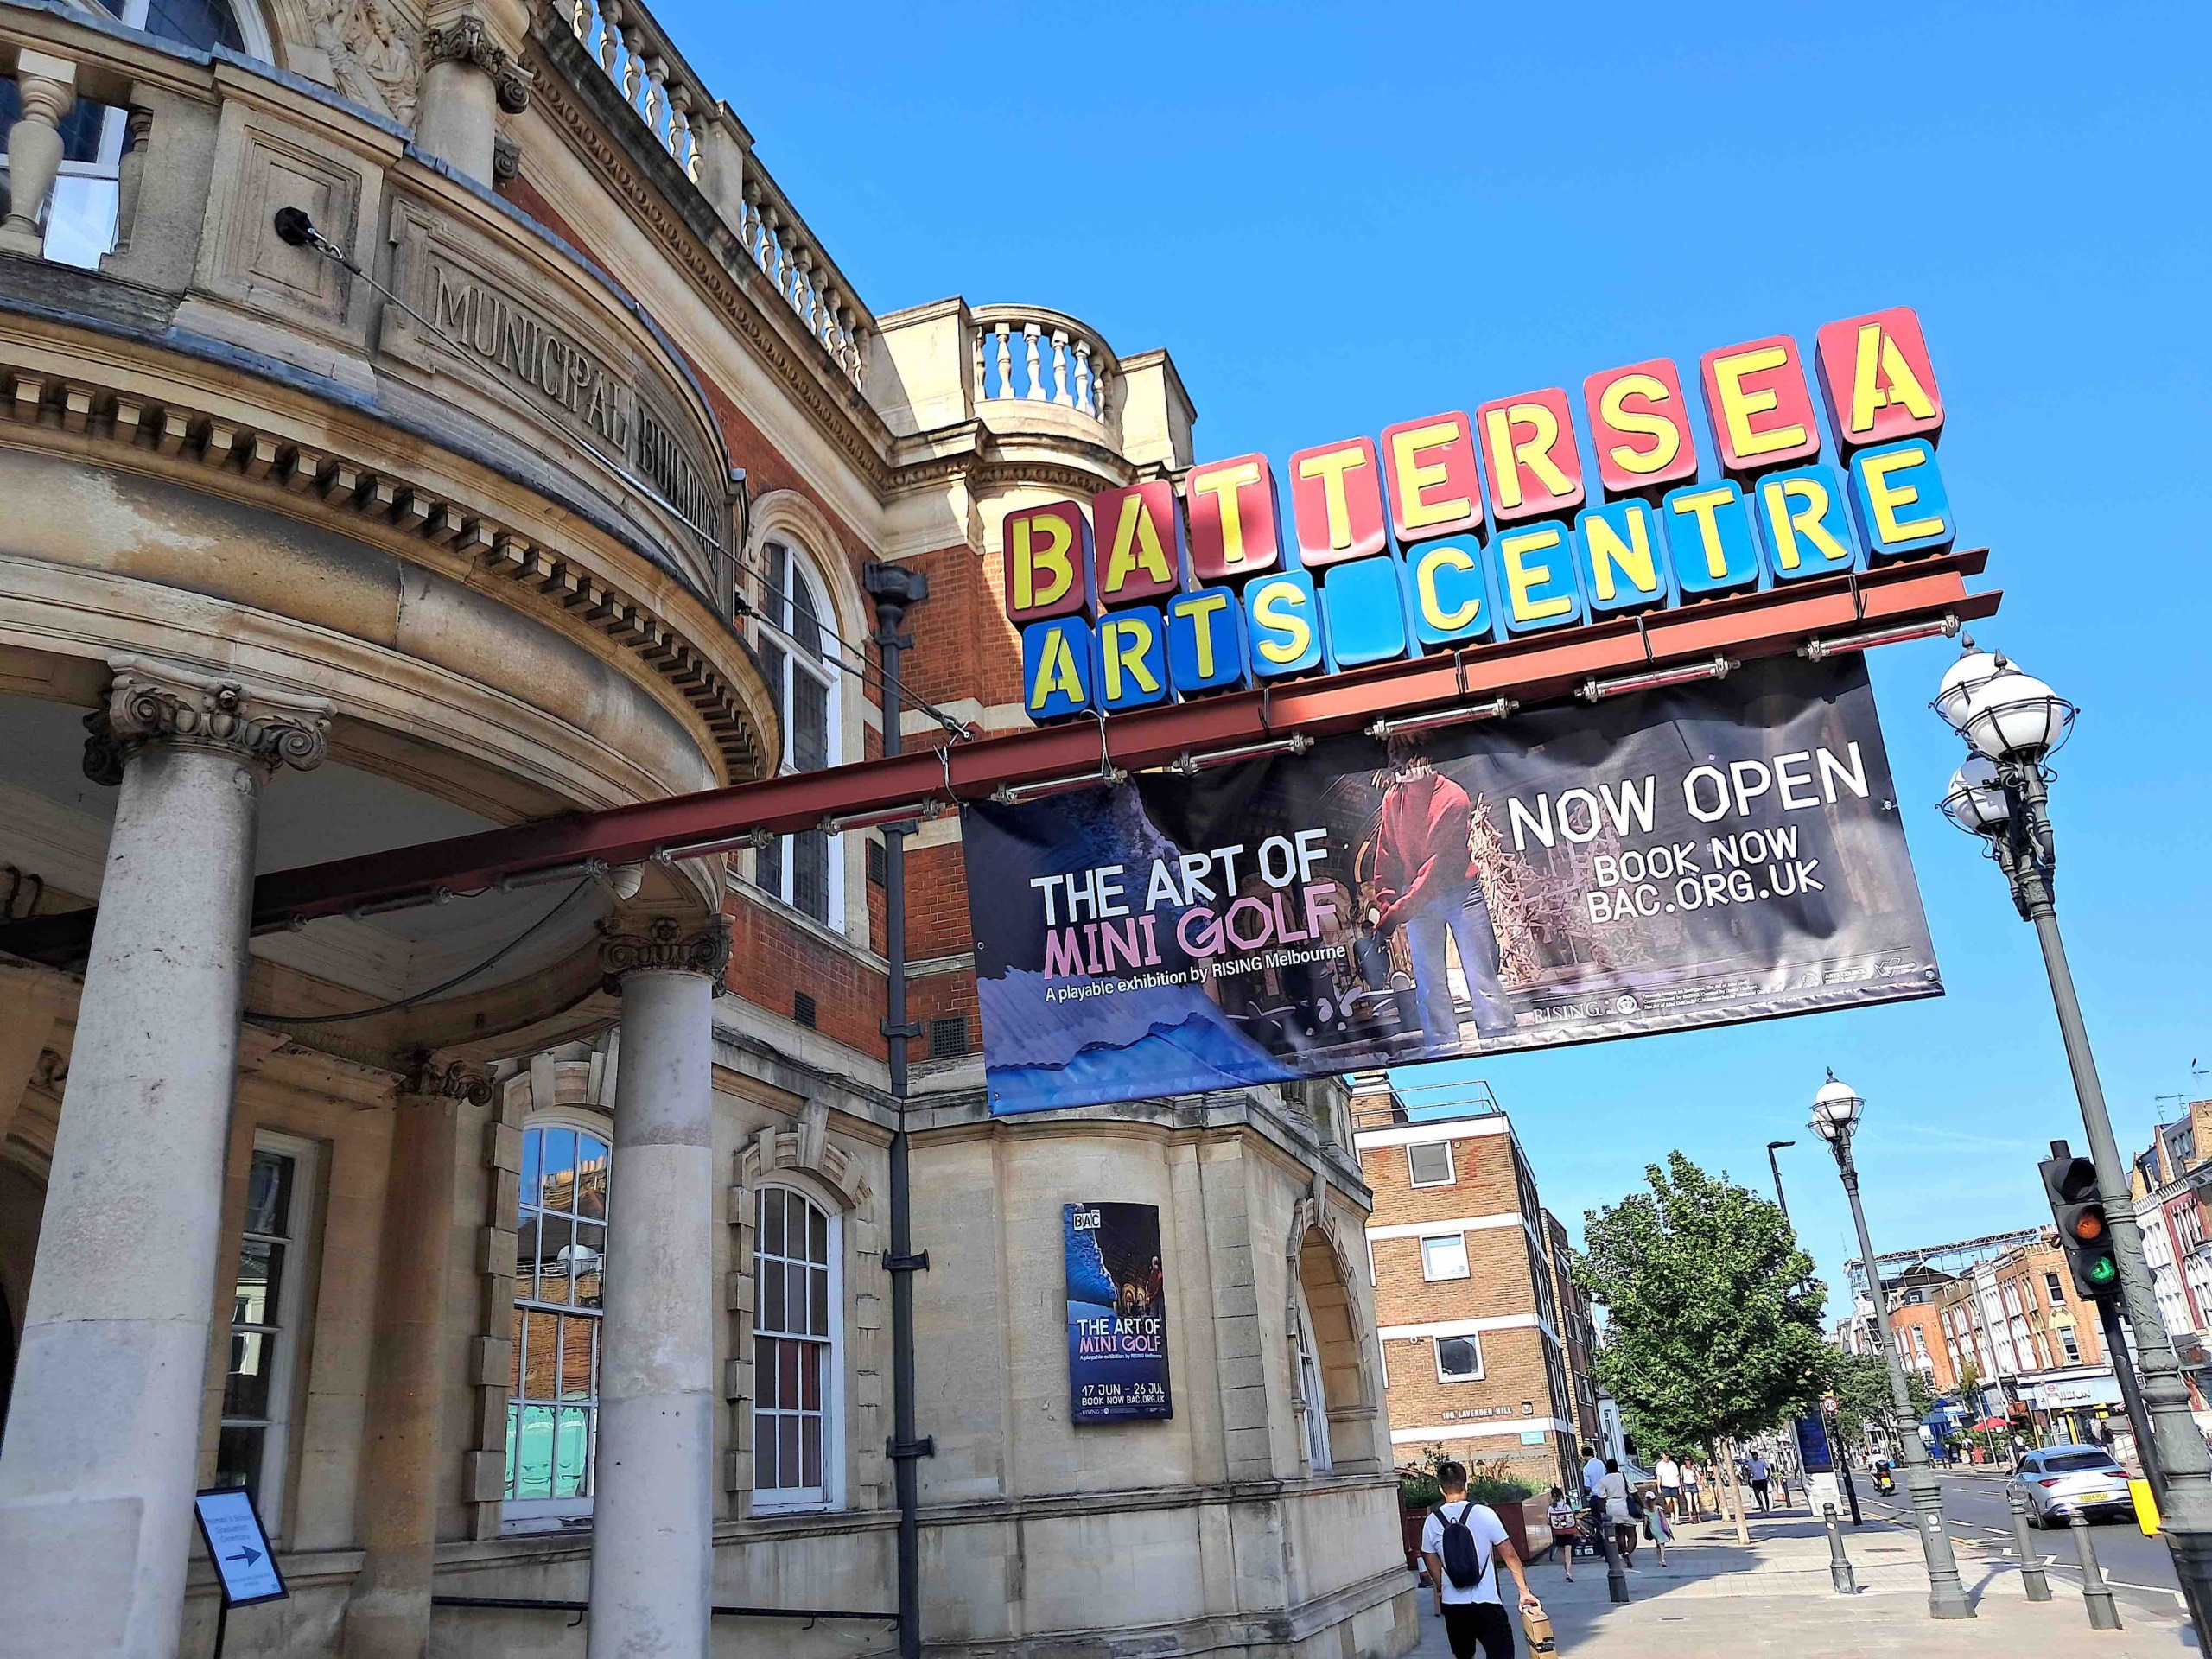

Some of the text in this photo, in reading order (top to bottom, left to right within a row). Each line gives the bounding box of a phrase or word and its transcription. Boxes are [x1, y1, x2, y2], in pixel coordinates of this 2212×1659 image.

[434, 266, 627, 454] MUNICIPAL
[1011, 322, 1937, 611] BATTERSEA
[1030, 447, 1945, 710] ARTS CENTRE
[1508, 741, 1871, 851] NOW OPEN
[1030, 827, 1328, 925] THE ART OF
[1593, 825, 1799, 888] BOOK NOW
[1586, 858, 1825, 925] BAC.ORG.UK
[1044, 883, 1337, 980] MINI GOLF
[1045, 945, 1346, 1004] A playable exhibition by RISING Melbourne
[1074, 1214, 1100, 1228] BAC
[1077, 1318, 1160, 1336] THE ART OF
[1079, 1334, 1161, 1354] MINI GOLF
[1082, 1385, 1095, 1397] 17
[1098, 1383, 1121, 1396] JUN
[1134, 1382, 1146, 1395] 26
[1148, 1382, 1165, 1395] JUL
[1082, 1395, 1166, 1406] BOOK NOW BAC.ORG.UK
[1458, 1407, 1494, 1419] LAVENDER
[1495, 1405, 1513, 1416] HILL
